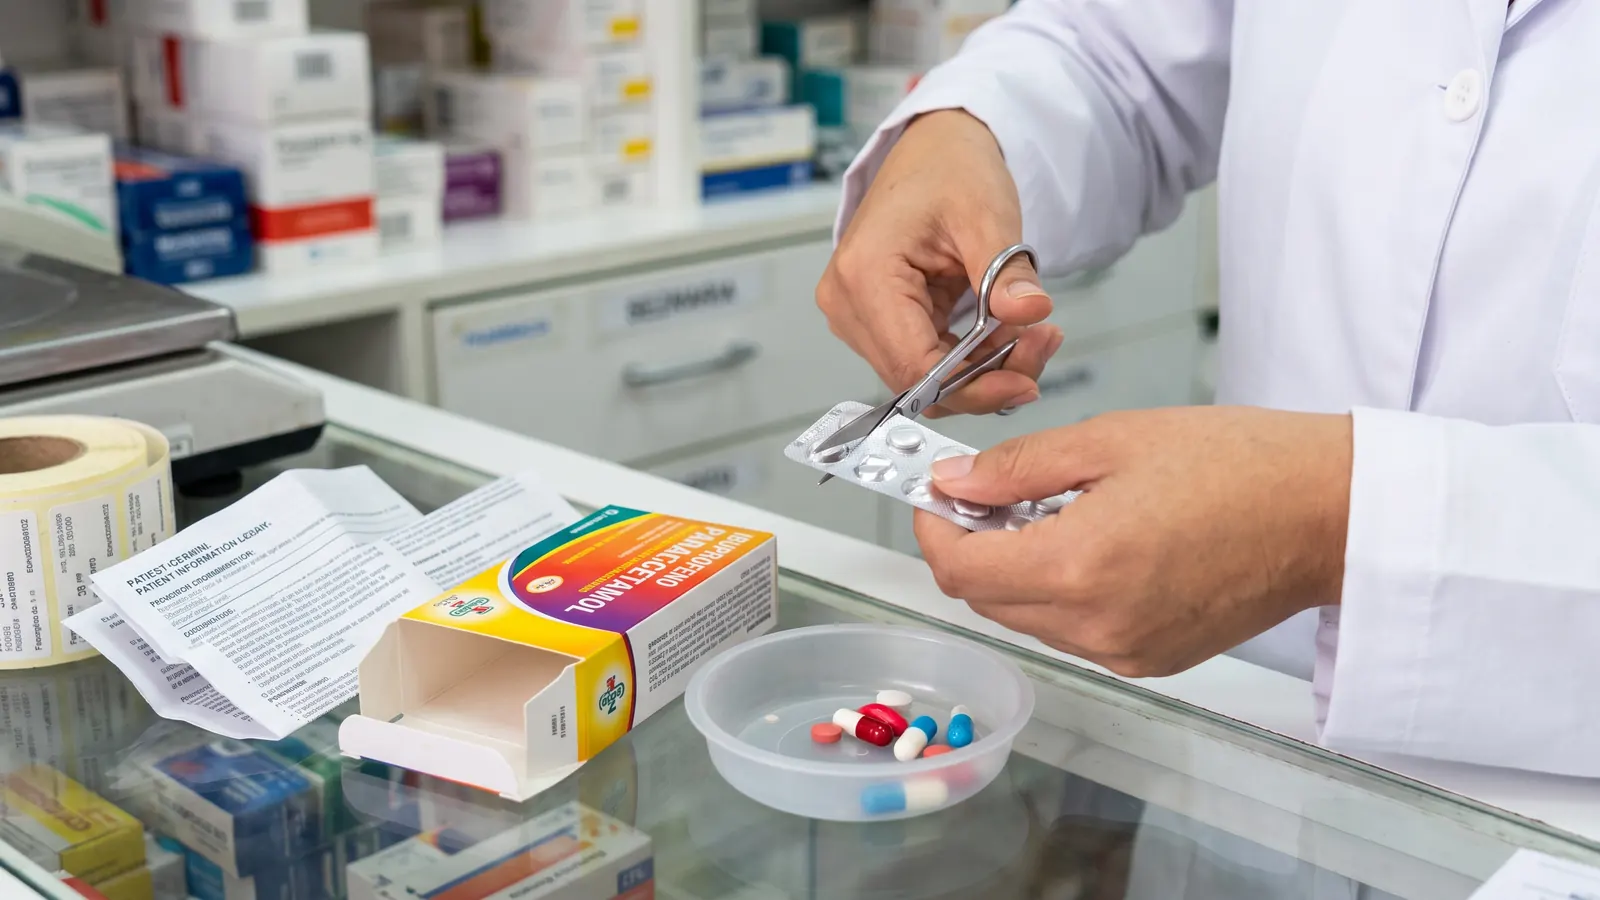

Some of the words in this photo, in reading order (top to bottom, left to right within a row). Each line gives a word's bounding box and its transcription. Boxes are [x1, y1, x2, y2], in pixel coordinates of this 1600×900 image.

[126, 563, 168, 587] PATIEST
[135, 572, 176, 596] PATIENT
[175, 539, 238, 576] INFORMATION
[655, 532, 753, 588] IBUPROFENO
